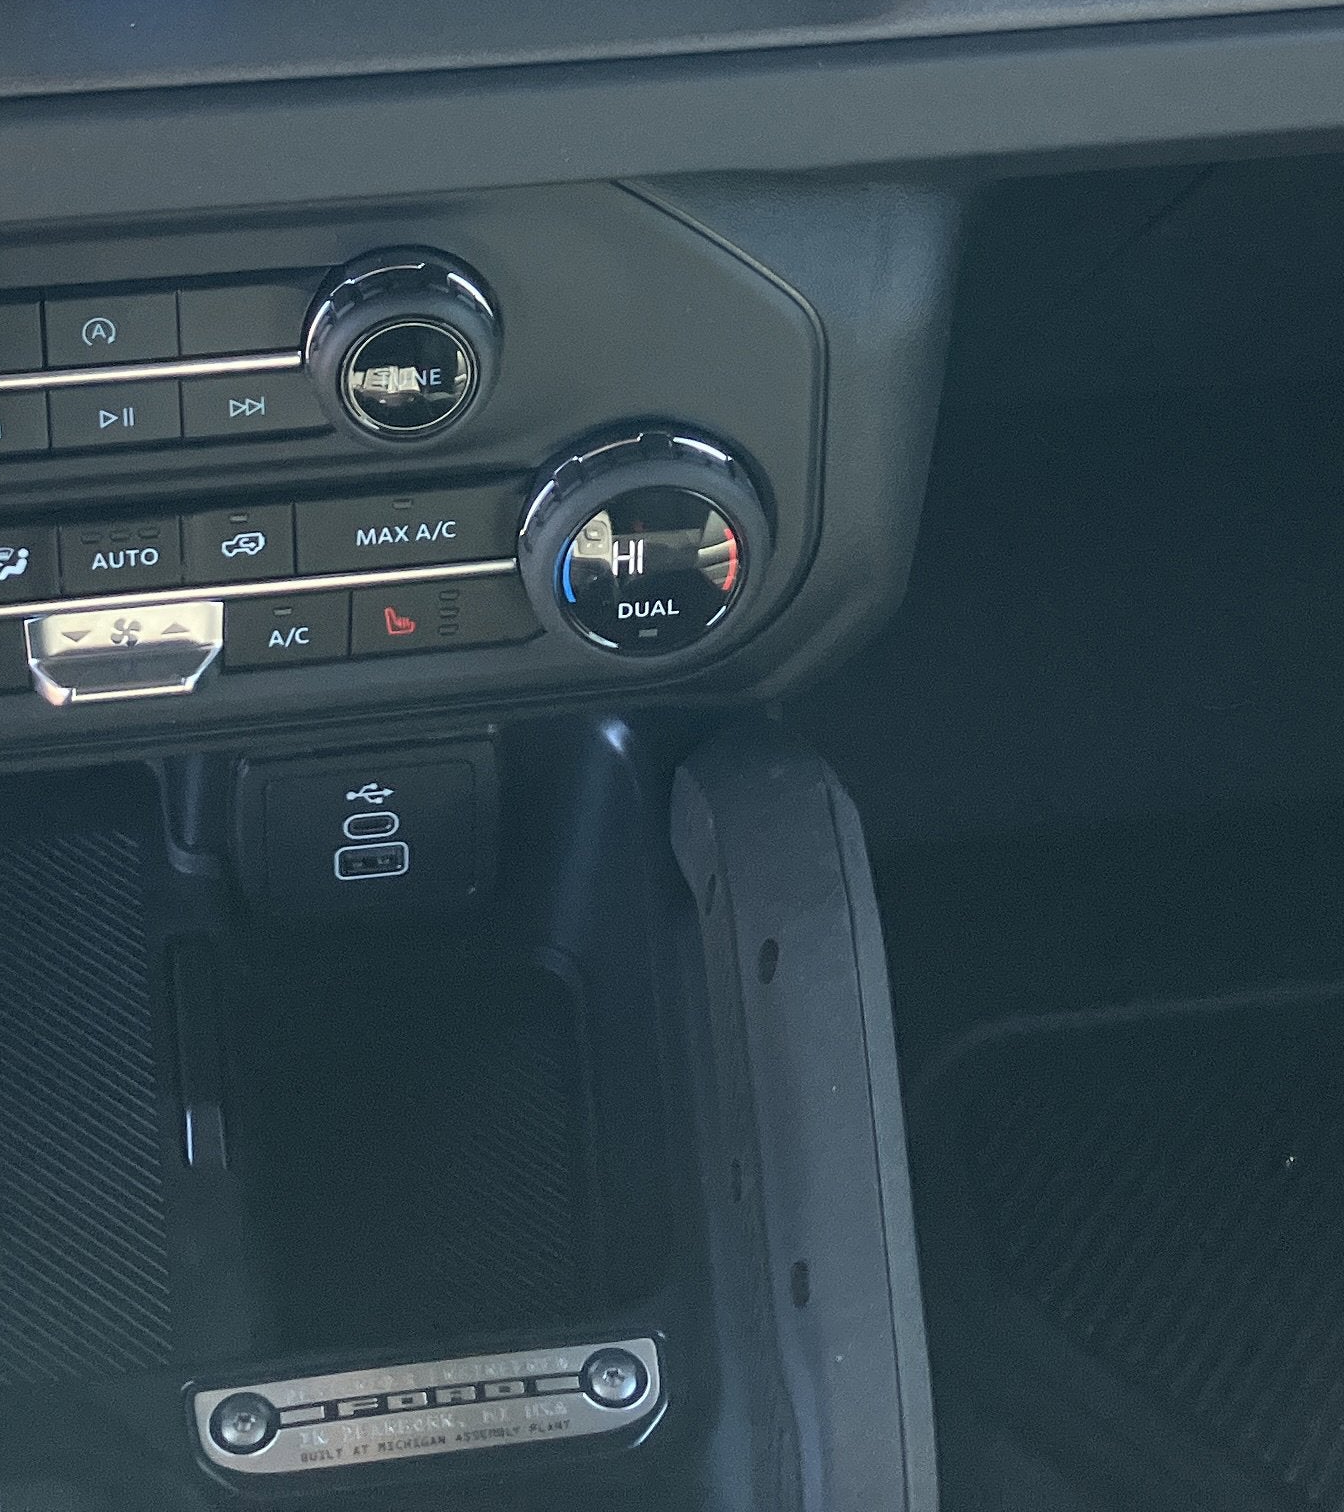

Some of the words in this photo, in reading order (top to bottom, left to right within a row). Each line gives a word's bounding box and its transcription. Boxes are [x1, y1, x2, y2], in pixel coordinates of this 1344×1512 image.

[357, 524, 412, 546] MAX
[414, 520, 457, 542] A/C
[91, 548, 159, 570] AUTO
[611, 539, 645, 577] HI
[617, 598, 680, 620] DUAL
[268, 626, 310, 649] A/C
[337, 1380, 525, 1417] FORD
[300, 1447, 344, 1463] BUILT
[352, 1443, 370, 1456] AT
[377, 1435, 447, 1453] MICHIGAN
